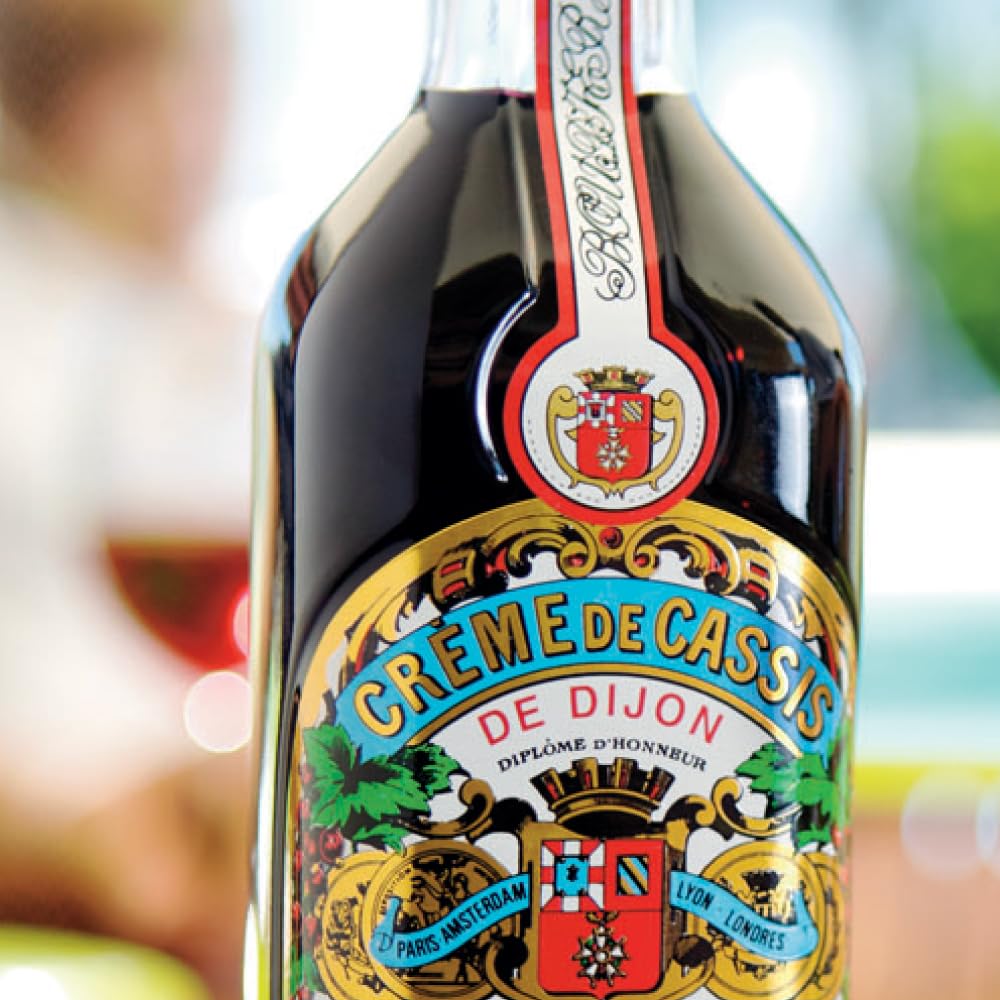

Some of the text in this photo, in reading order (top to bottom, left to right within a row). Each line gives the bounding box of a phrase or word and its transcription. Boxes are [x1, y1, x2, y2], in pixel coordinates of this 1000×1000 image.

[583, 603, 645, 653] DE
[655, 597, 833, 742] CASSIS
[478, 683, 724, 746] DE DIJON
[593, 738, 708, 772] D'HONNEUR
[396, 934, 440, 960] PARIS
[439, 882, 527, 945] AMSTERDAM
[676, 879, 786, 951] LYON LONDRES
